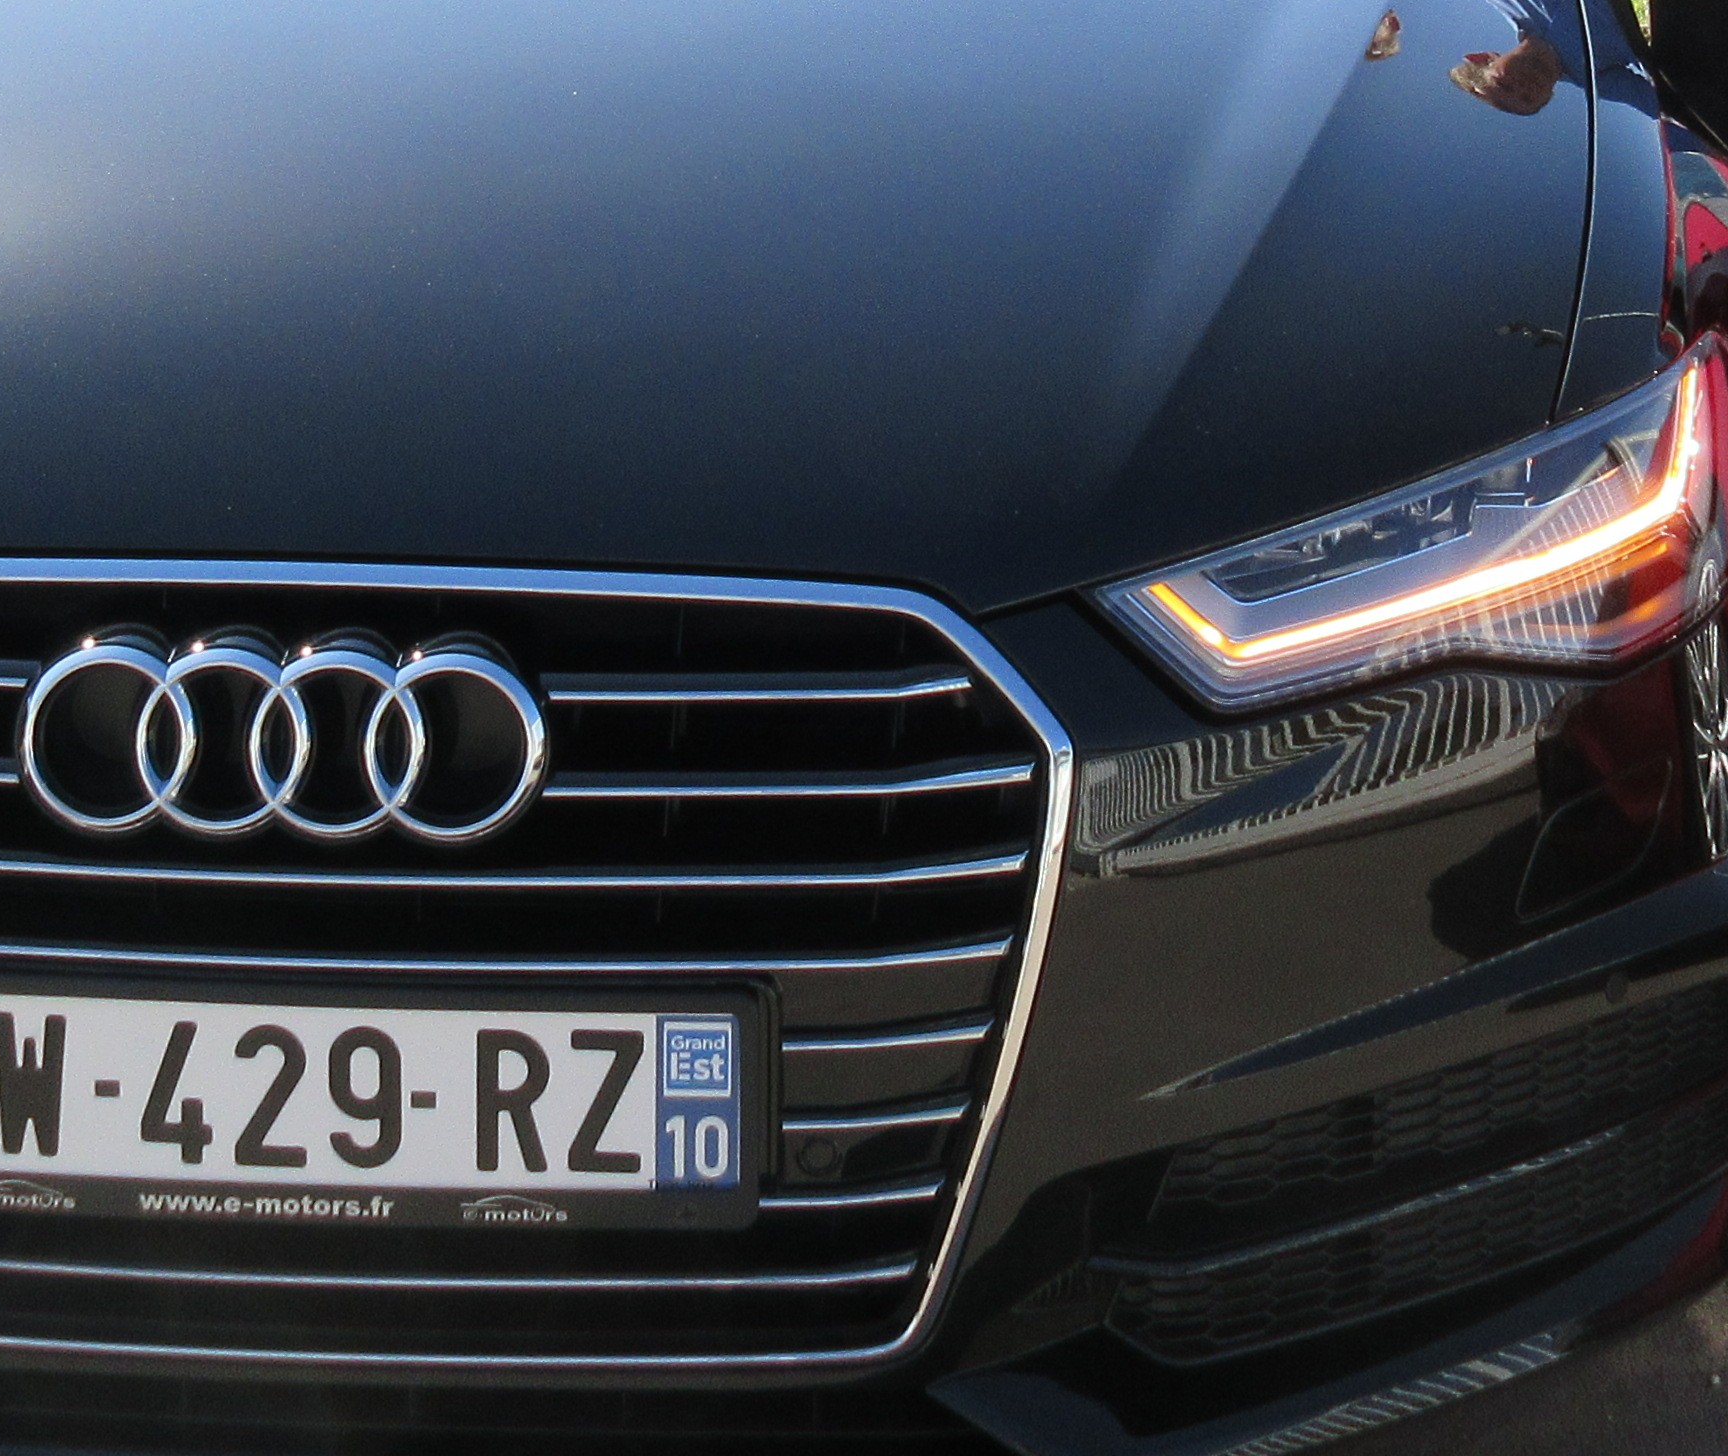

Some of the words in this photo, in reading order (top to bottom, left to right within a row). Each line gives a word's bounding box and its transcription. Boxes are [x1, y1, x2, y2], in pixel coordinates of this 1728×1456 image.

[671, 1035, 726, 1051] Grand
[670, 1052, 725, 1081] Est
[666, 1115, 729, 1179] 10
[139, 1193, 395, 1218] www.e-motors.fr
